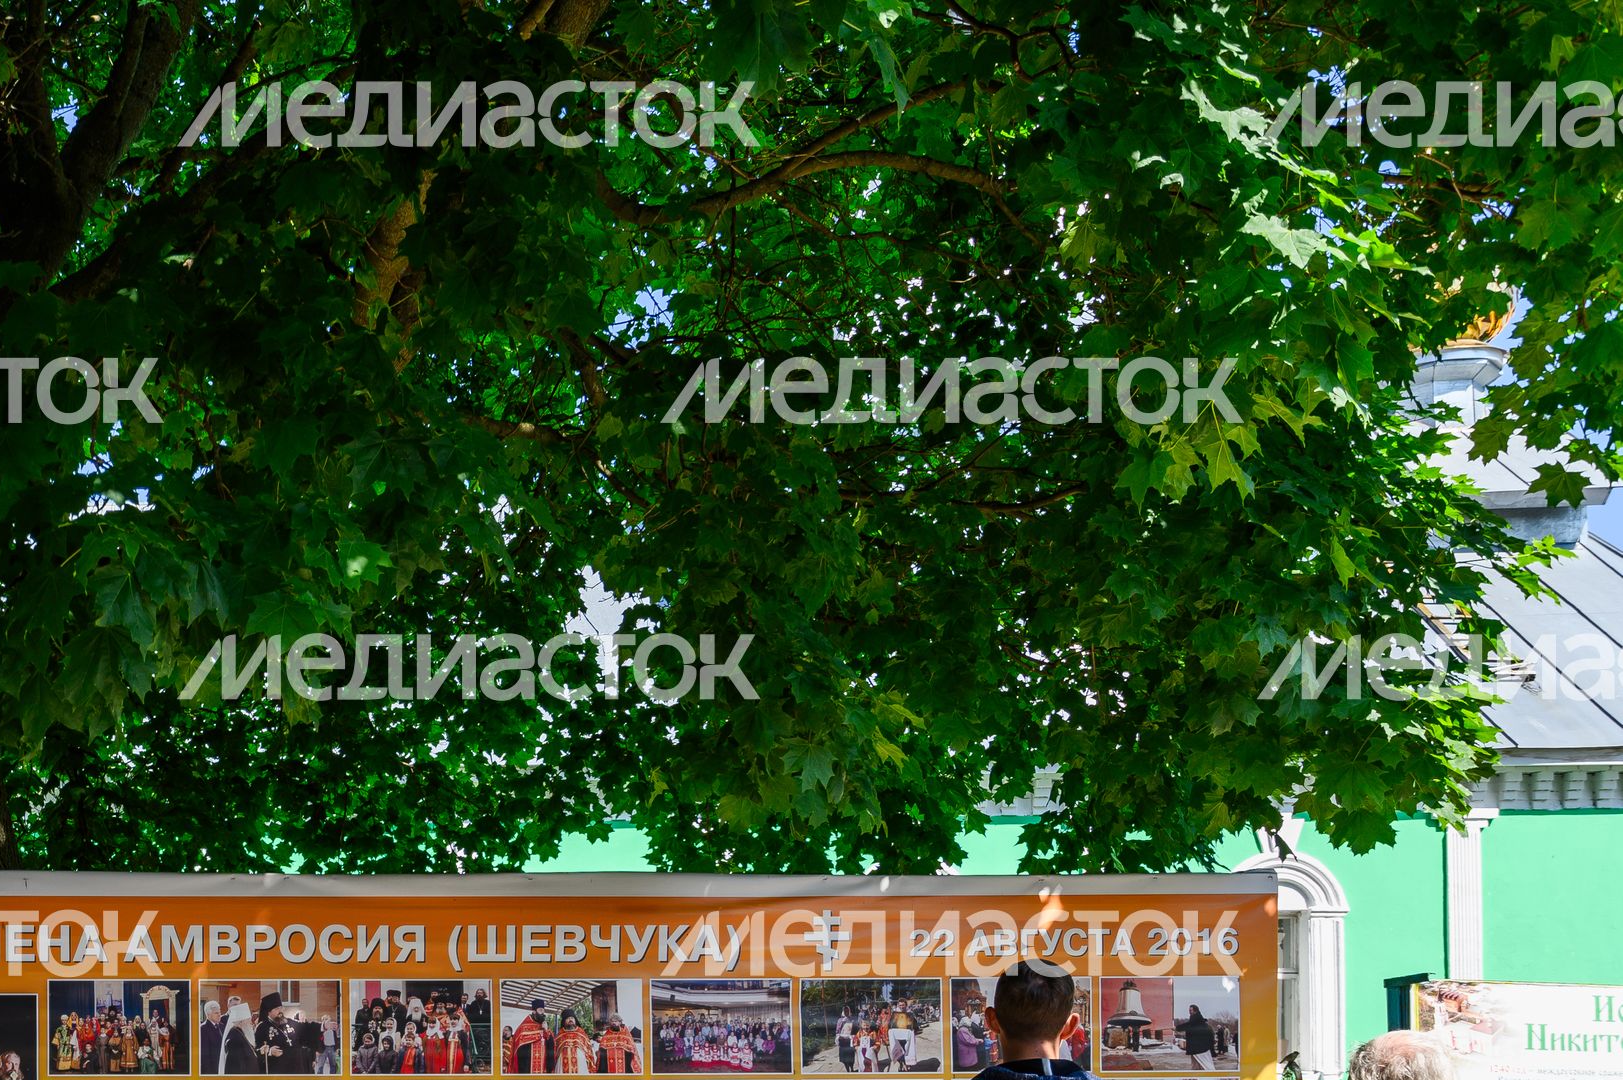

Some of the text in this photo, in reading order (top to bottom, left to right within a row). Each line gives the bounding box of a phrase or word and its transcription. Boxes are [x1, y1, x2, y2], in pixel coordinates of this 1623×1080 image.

[123, 924, 426, 965] АМВРОСИЯ
[447, 923, 742, 972] (ШЕВЧУКА)
[908, 928, 1240, 958] 22 АВГУСТА 2016
